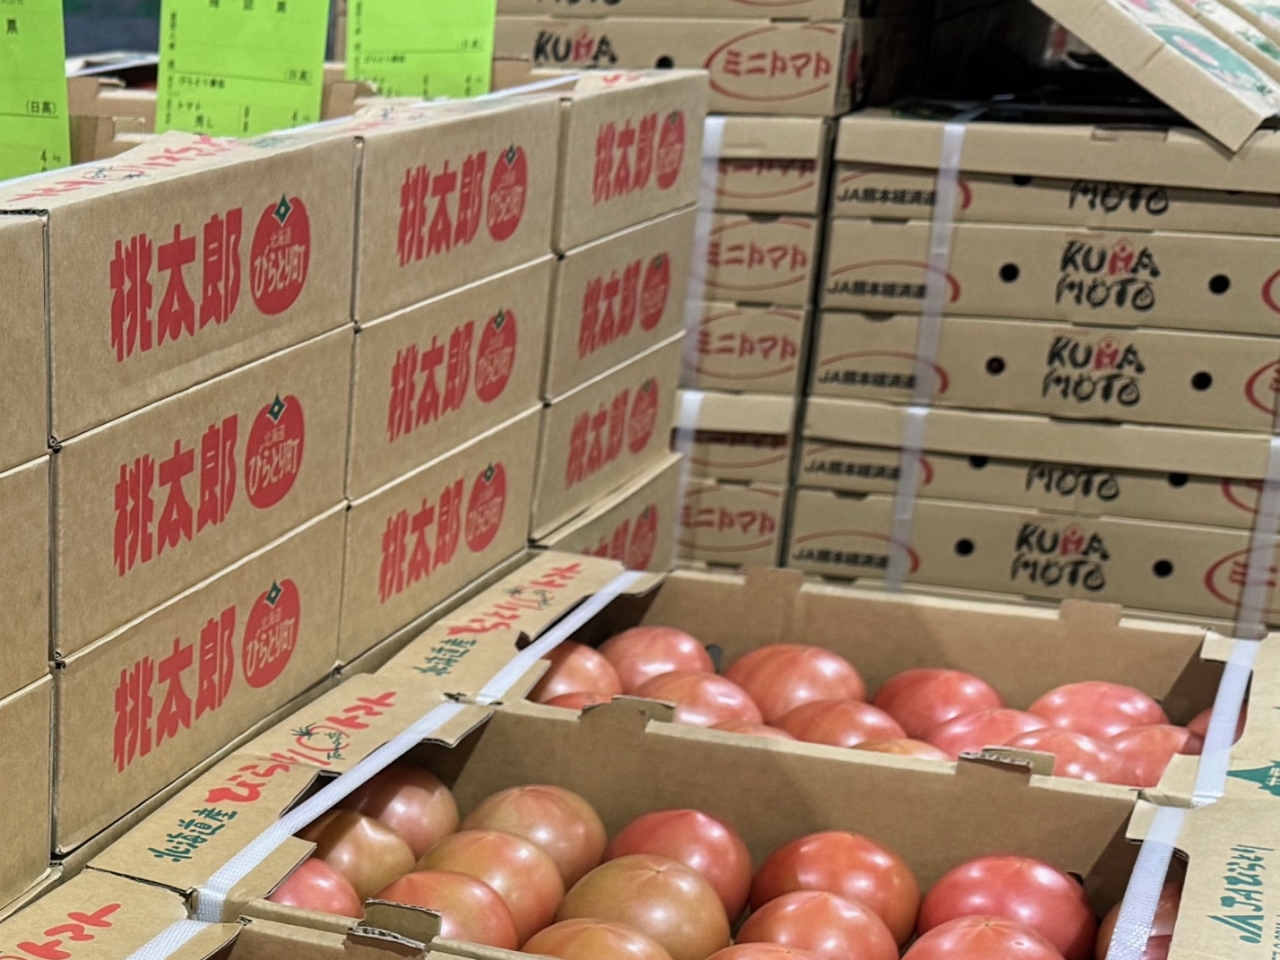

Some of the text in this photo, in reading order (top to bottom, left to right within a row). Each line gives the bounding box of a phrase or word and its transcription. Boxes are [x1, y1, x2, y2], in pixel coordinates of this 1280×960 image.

[723, 50, 833, 79] ミニトマト
[397, 152, 487, 267] 桃太郎
[111, 209, 242, 361] 桃太郎
[253, 241, 306, 298] びらとり町
[1055, 275, 1156, 312] MOTO
[387, 321, 475, 442] 桃太郎
[1041, 368, 1142, 406] MOTO
[249, 436, 300, 495] びらとり町
[1025, 463, 1121, 502] MOTO
[114, 416, 238, 575] 桃太郎
[379, 478, 465, 602] 桃太郎
[1009, 554, 1107, 593] MOTO
[246, 616, 295, 676] びらとり町
[114, 607, 236, 771] 桃太郎
[325, 692, 397, 730] トマト
[147, 807, 239, 863] 北海道産
[16, 903, 122, 960] トマト
